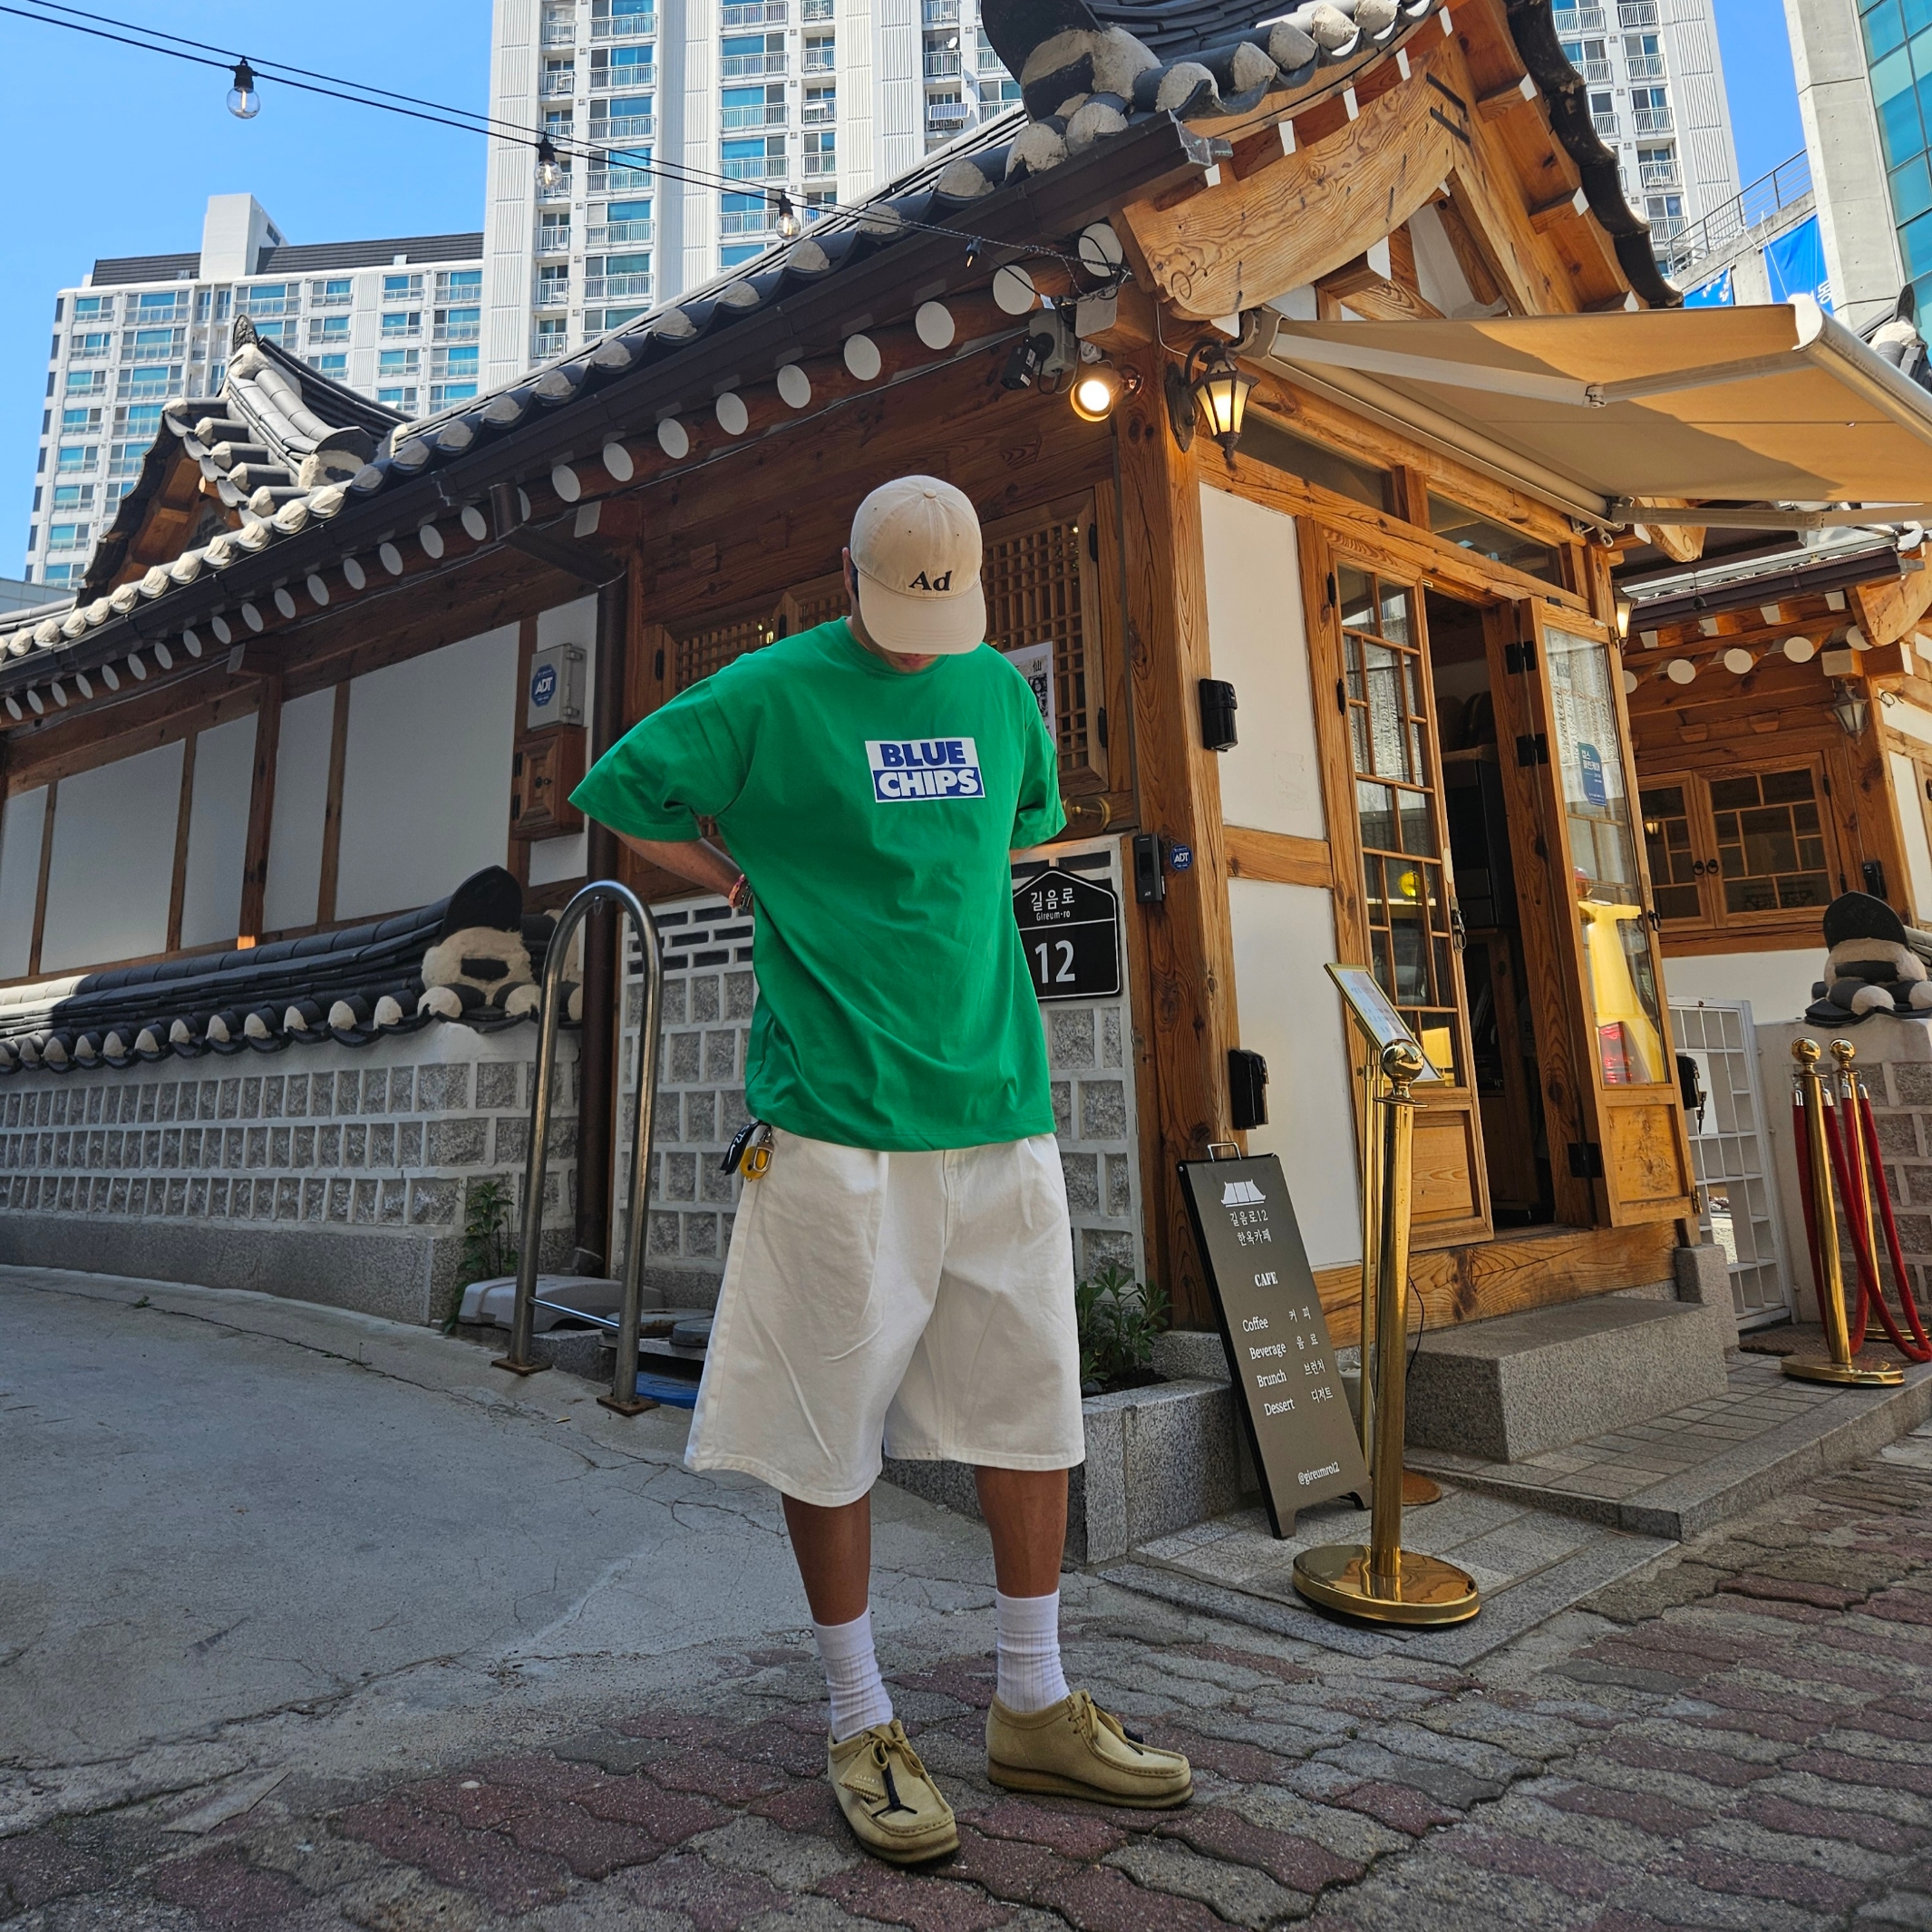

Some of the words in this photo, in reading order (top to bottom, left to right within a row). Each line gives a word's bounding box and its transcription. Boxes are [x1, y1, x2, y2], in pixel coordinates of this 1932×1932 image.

[908, 570, 953, 592] Ad
[534, 676, 553, 695] ADT
[879, 741, 966, 768] BLUE
[877, 768, 980, 798] CHIPS
[1173, 852, 1189, 863] ADT
[1030, 888, 1075, 912] 길음로
[1034, 940, 1076, 984] 12
[1229, 1209, 1268, 1228] 길음로12
[1237, 1228, 1272, 1247] 한옥카페
[1254, 1272, 1278, 1287] CAFE
[1242, 1316, 1269, 1333] Coffee
[1249, 1342, 1286, 1360] Beverage
[1257, 1369, 1287, 1388] Brunch
[1304, 1358, 1326, 1375] 브런치
[1264, 1398, 1296, 1416] Dessert
[1311, 1386, 1334, 1403] 디저트
[1297, 1461, 1341, 1486] @gireumro12
